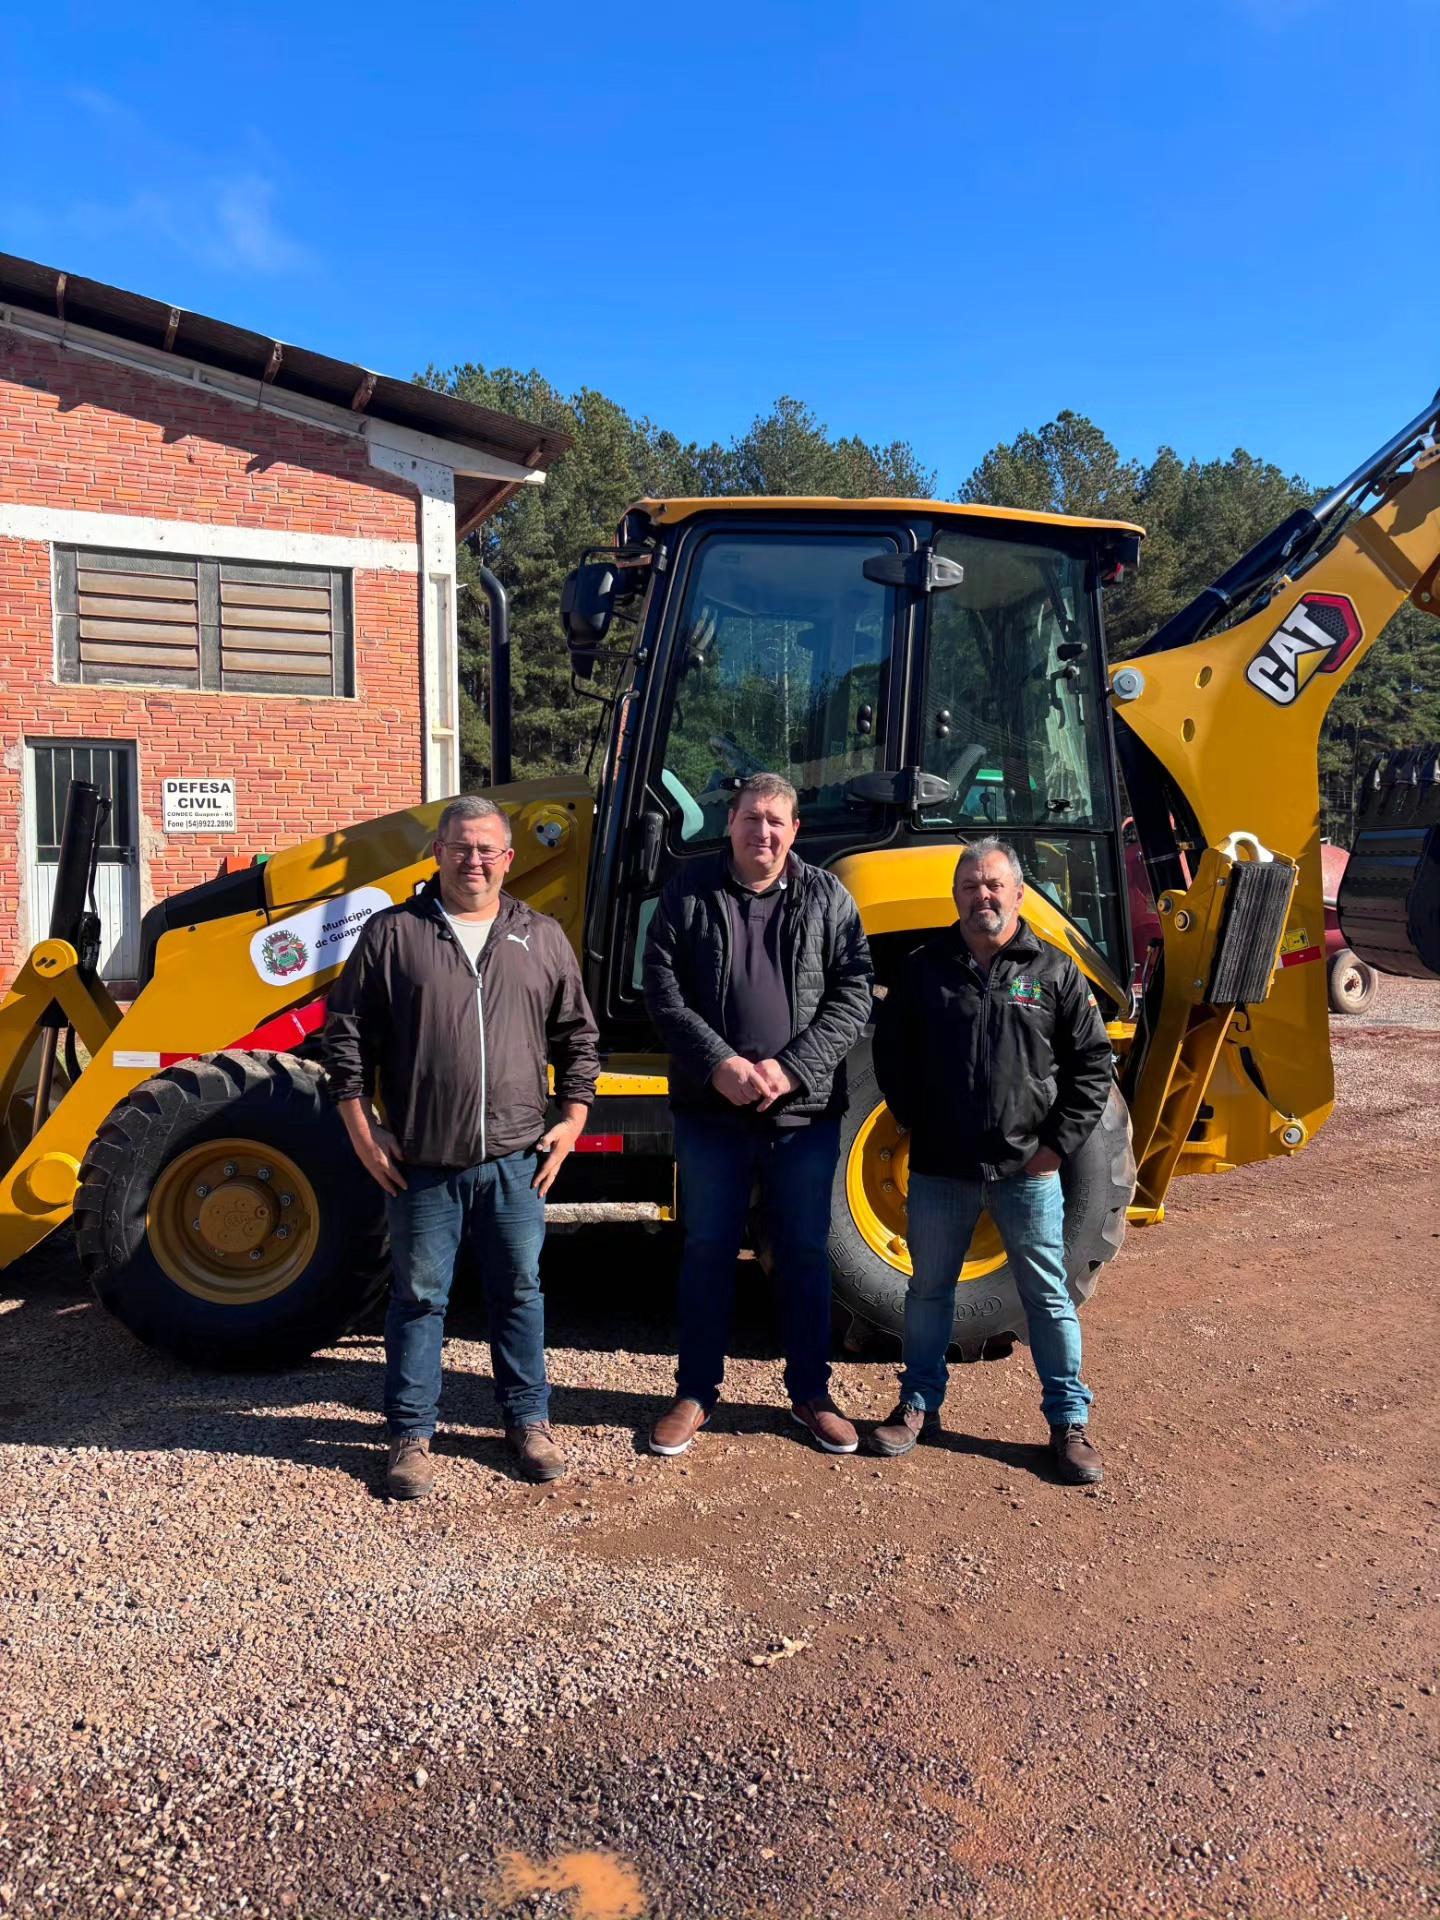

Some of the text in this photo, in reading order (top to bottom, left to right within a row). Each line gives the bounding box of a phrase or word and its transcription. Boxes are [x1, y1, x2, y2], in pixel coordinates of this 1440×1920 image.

[1246, 602, 1337, 704] CAT
[167, 782, 231, 793] DEFESA
[178, 797, 222, 809] CIVIL
[167, 820, 184, 828] Fone
[315, 940, 329, 949] de
